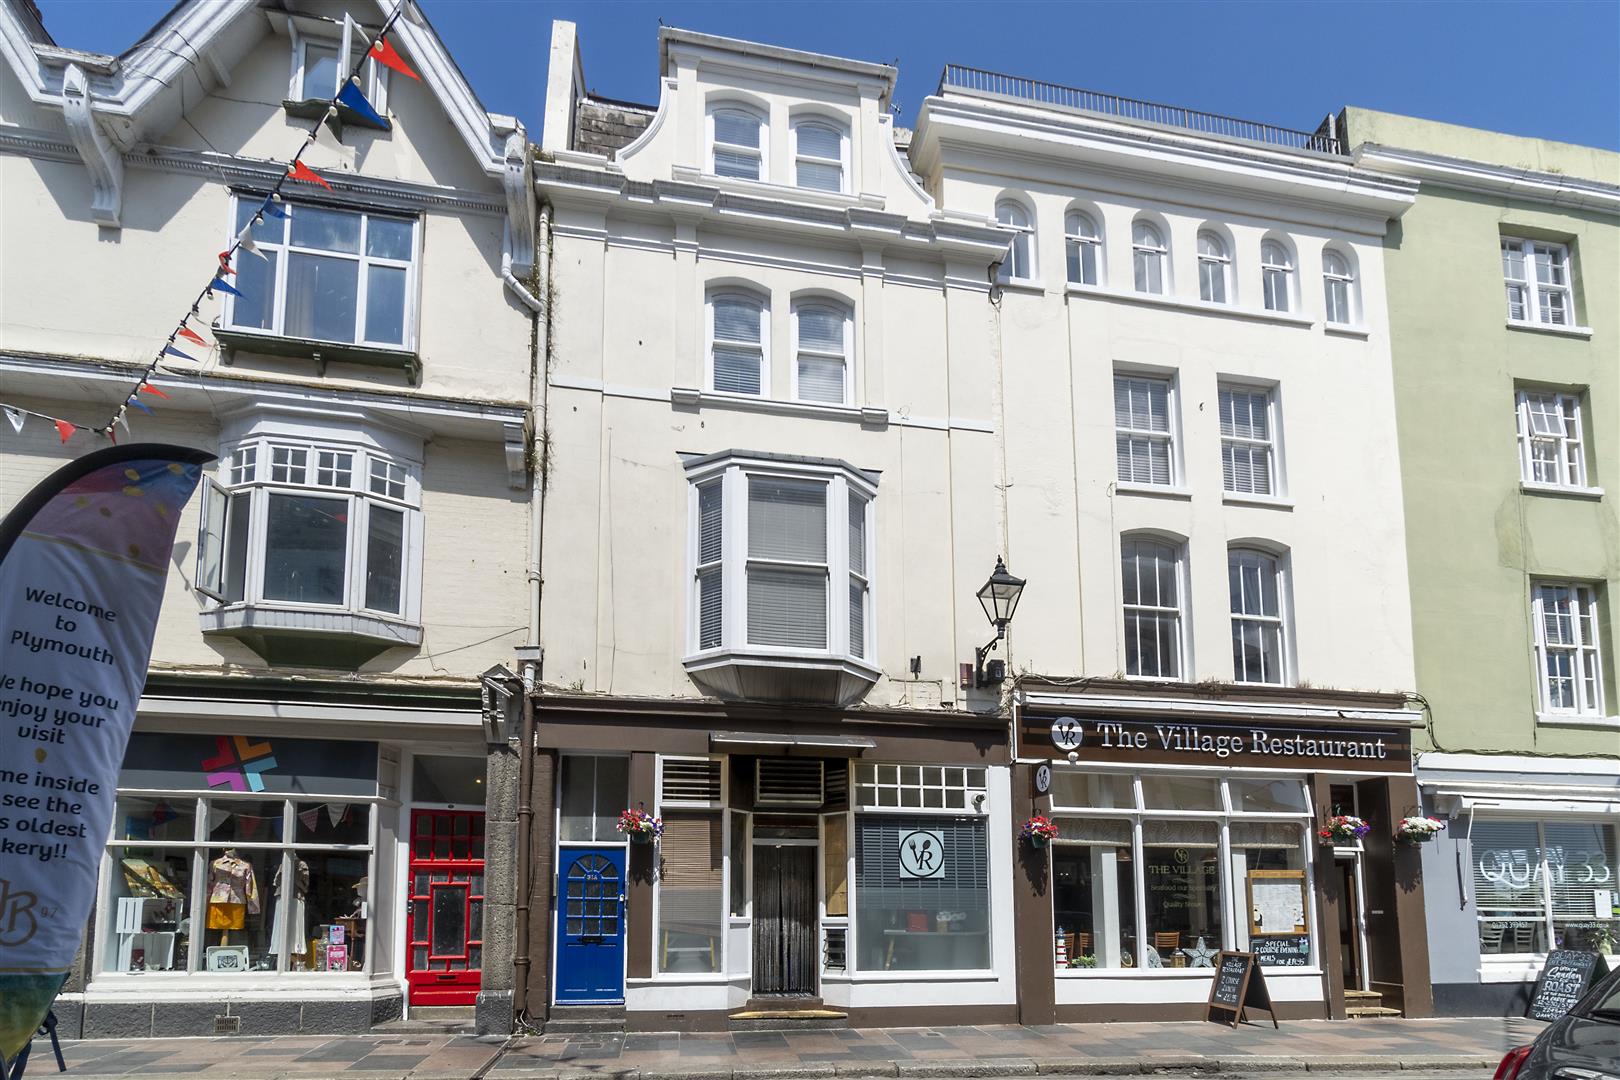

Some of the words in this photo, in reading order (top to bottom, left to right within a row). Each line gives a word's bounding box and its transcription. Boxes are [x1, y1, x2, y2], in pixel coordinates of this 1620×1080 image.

[26, 587, 117, 622] Welcome
[55, 614, 76, 633] to
[11, 630, 115, 665] Plymouth
[20, 676, 74, 700] hope
[79, 691, 119, 711] you
[0, 698, 48, 722] njoy
[53, 705, 105, 728] your
[18, 725, 66, 745] visit
[1097, 722, 1148, 749] The
[1154, 725, 1243, 758] Village
[1250, 729, 1387, 760] Restaurant
[35, 771, 100, 796] inside
[2, 794, 40, 809] see
[46, 796, 82, 815] the
[16, 817, 87, 839] oldest
[908, 839, 934, 870] VR
[1148, 865, 1170, 874] THE
[1172, 865, 1216, 874] VILLAGE
[1480, 848, 1567, 888] QUAY
[1577, 850, 1610, 882] 33
[1553, 952, 1577, 961] QUAY
[1544, 981, 1581, 994] ROAST
